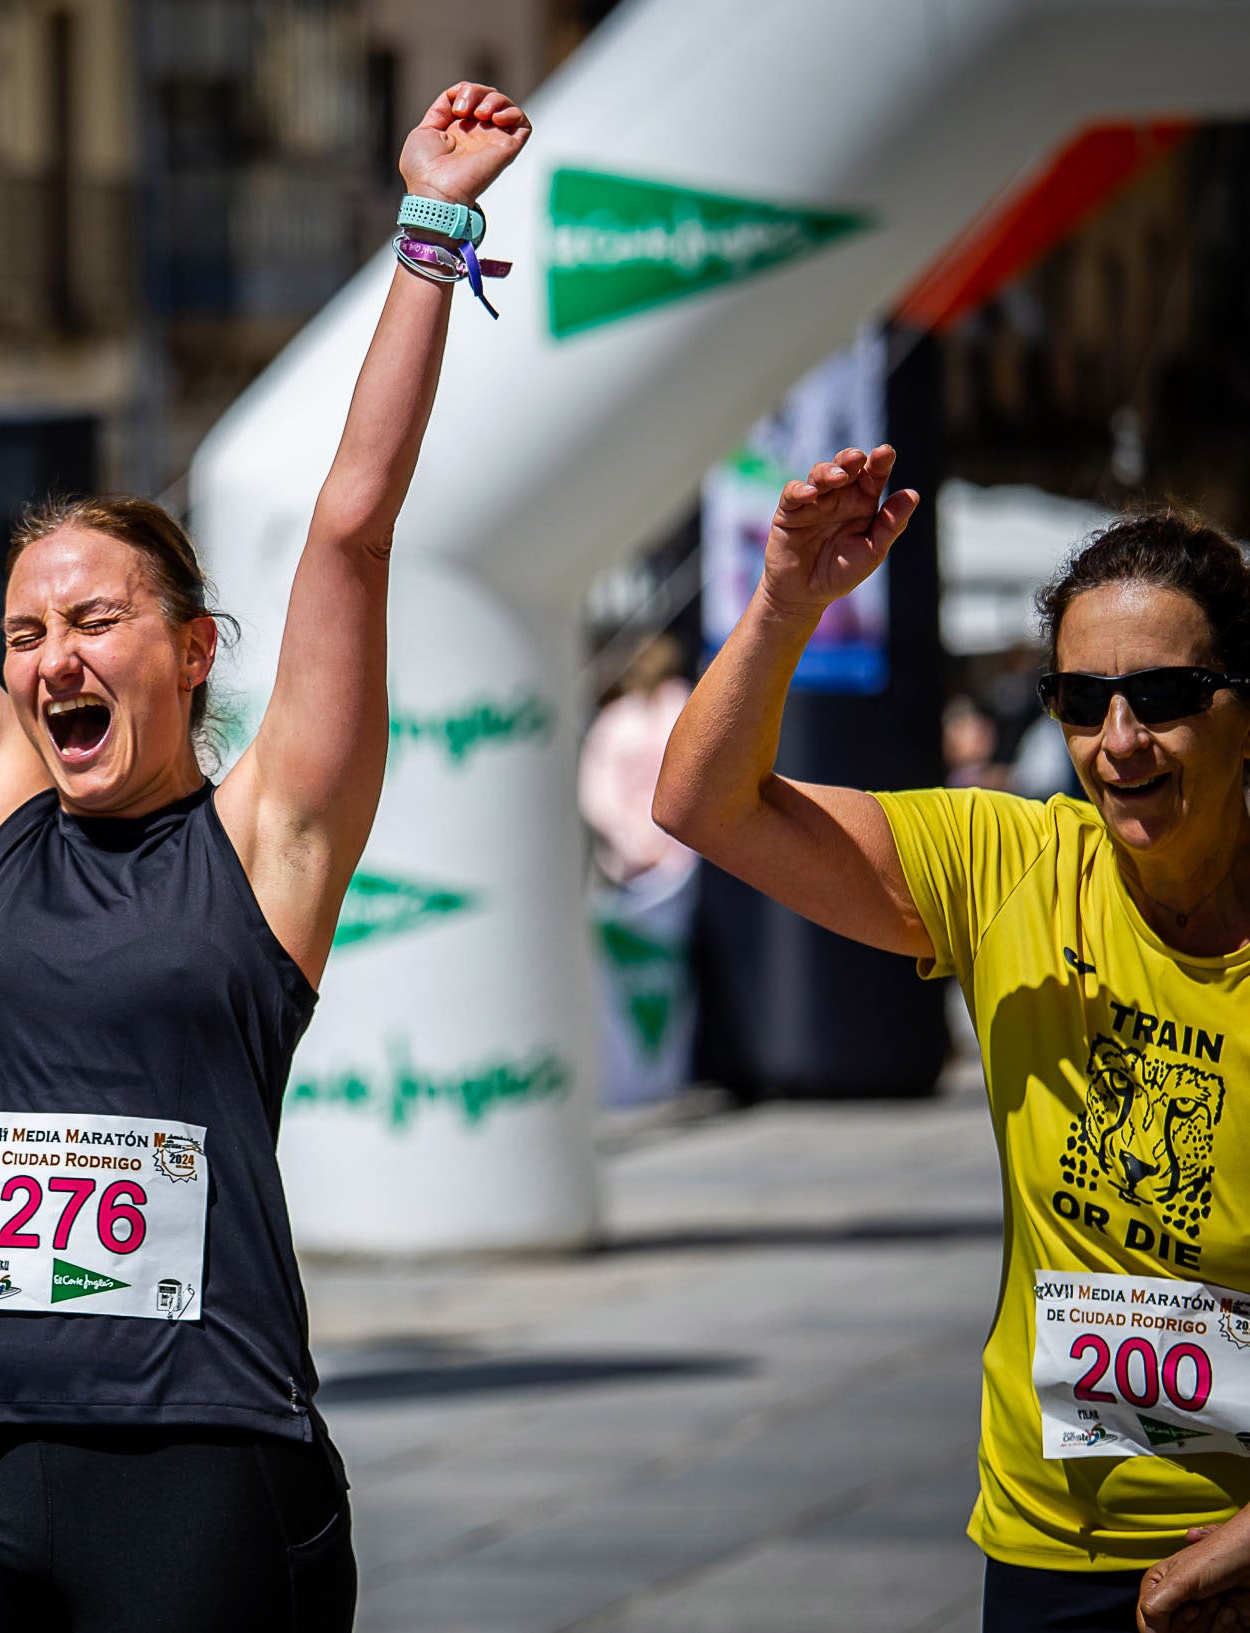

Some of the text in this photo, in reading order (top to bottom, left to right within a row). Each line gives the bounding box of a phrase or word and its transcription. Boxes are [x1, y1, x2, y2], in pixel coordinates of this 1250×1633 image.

[1110, 1002, 1224, 1063] TRAIN
[12, 1128, 60, 1143] MEDIA
[65, 1129, 149, 1147] MARATÓN
[2, 1151, 60, 1166] CIUDAD
[65, 1152, 142, 1171] RODRIGO
[169, 1153, 194, 1165] 2024
[1052, 1191, 1202, 1271] OR DIE
[62, 1275, 83, 1285] Corte
[83, 1273, 114, 1290] Inglés
[1044, 1282, 1073, 1299] XVII
[1078, 1285, 1126, 1303] MEDIA
[1131, 1289, 1214, 1312] MARATÓN
[1047, 1308, 1207, 1335] DE CIUDAD RODRIGO
[1069, 1333, 1212, 1412] 200
[1077, 1408, 1100, 1420] PILAR
